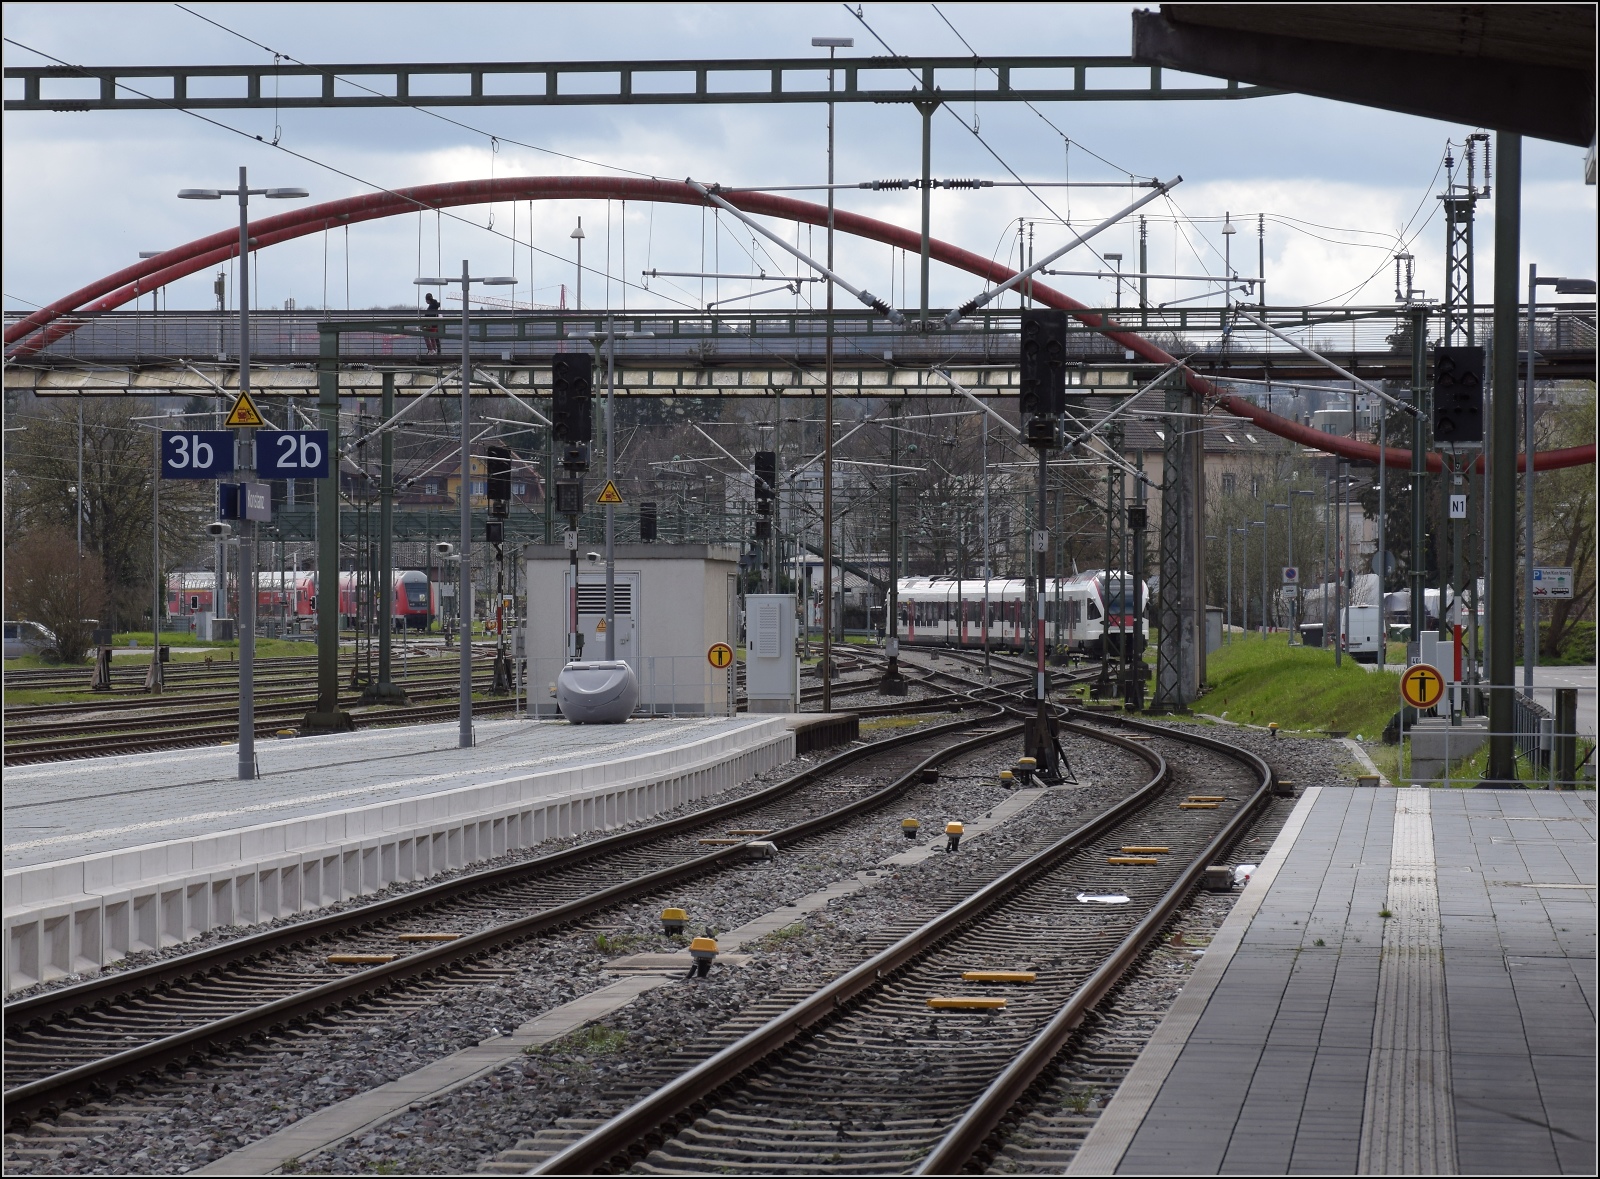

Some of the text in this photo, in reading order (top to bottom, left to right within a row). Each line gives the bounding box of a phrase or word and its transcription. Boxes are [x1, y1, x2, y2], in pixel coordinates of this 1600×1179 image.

[167, 434, 214, 469] 3b
[276, 434, 322, 468] 2b
[247, 490, 265, 509] Konstanz
[1452, 501, 1464, 512] N1
[1037, 533, 1044, 541] N
[568, 541, 574, 549] 3
[1038, 542, 1044, 551] 2
[1533, 570, 1540, 580] P
